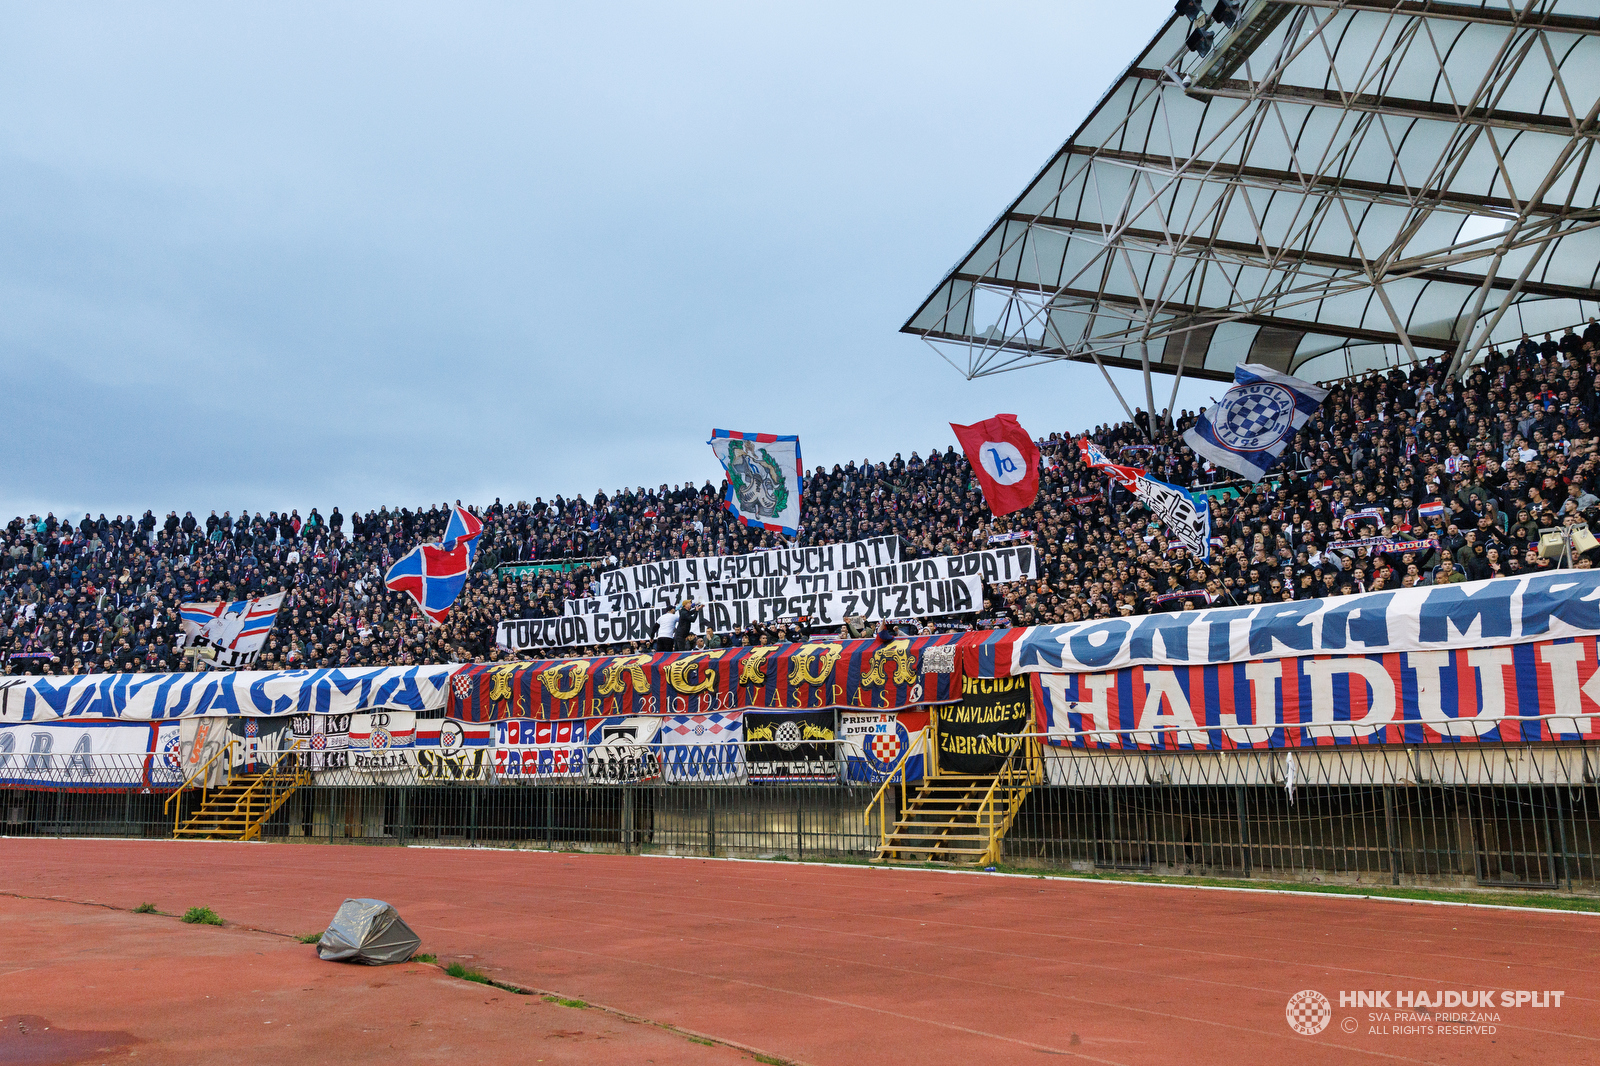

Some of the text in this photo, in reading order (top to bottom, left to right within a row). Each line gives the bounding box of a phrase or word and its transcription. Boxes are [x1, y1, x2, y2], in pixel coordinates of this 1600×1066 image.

[1385, 540, 1431, 552] HAJDUK
[603, 570, 629, 596] ZA
[633, 560, 680, 590] NAMI
[841, 536, 898, 570] LAT!
[501, 616, 589, 649] TORCIDA
[1019, 591, 1397, 668] KONTRA
[486, 638, 919, 703] TORCIDA
[638, 696, 659, 713] 28.
[666, 695, 687, 713] 10.
[697, 691, 736, 712] 1950.
[940, 702, 1026, 724] UZ NAVIJAČE SA
[842, 714, 896, 725] PRISUTAN
[846, 725, 887, 735] DUHOM
[496, 722, 585, 745] TORCIDA
[417, 748, 486, 780] SINJ
[495, 748, 584, 775] ZAGREB
[662, 738, 742, 777] TROGIR
